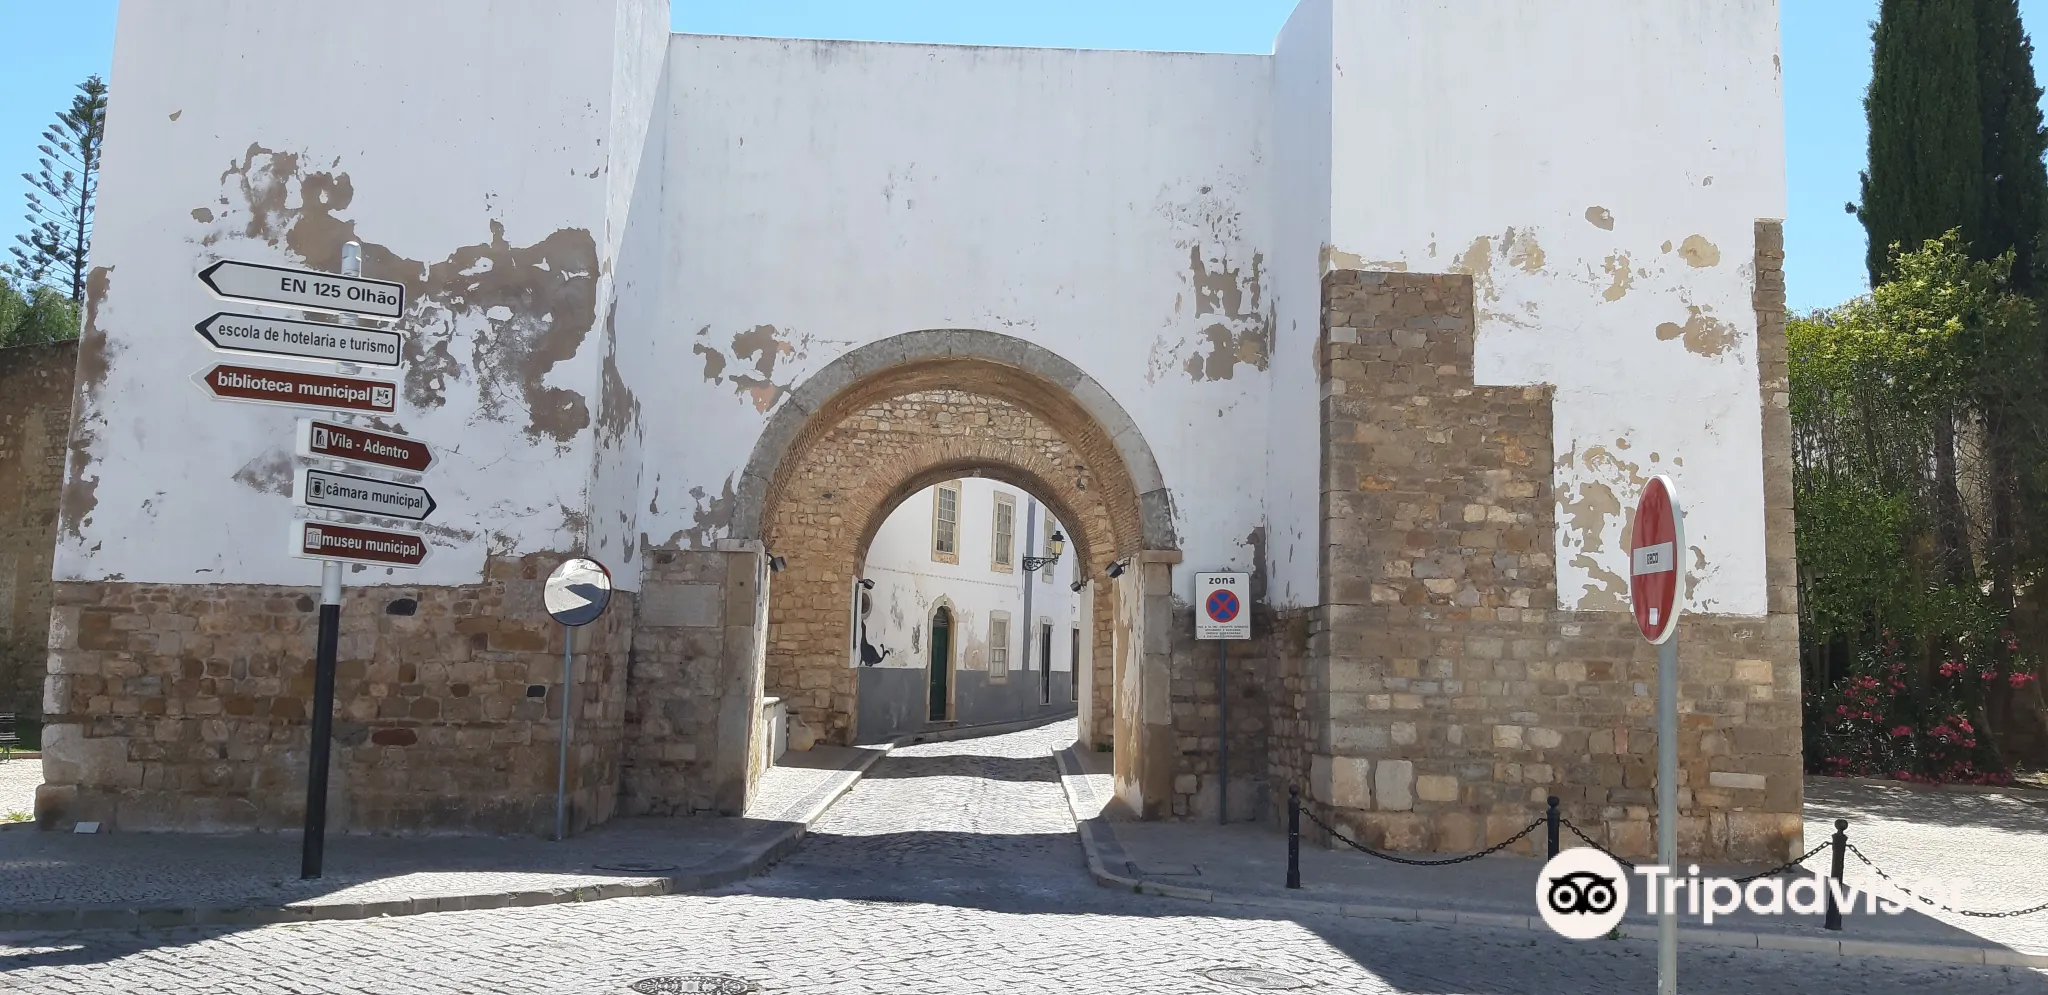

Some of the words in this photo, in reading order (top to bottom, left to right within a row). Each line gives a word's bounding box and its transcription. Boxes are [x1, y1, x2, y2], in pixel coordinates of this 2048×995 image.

[281, 277, 307, 294] EN
[313, 282, 341, 298] 125
[346, 286, 397, 306] Olhão
[218, 323, 260, 340] escola
[264, 327, 279, 341] de
[283, 329, 336, 348] hotelaria
[339, 338, 347, 349] e
[350, 337, 395, 355] turismo
[217, 371, 293, 393] biblioteca
[298, 382, 371, 402] municipal
[329, 431, 353, 450] Vila
[363, 438, 409, 460] Adentro
[326, 482, 368, 500] câmara
[371, 491, 423, 510] municipal
[321, 534, 362, 550] museu
[365, 539, 420, 557] municipal
[1208, 577, 1236, 585] zona
